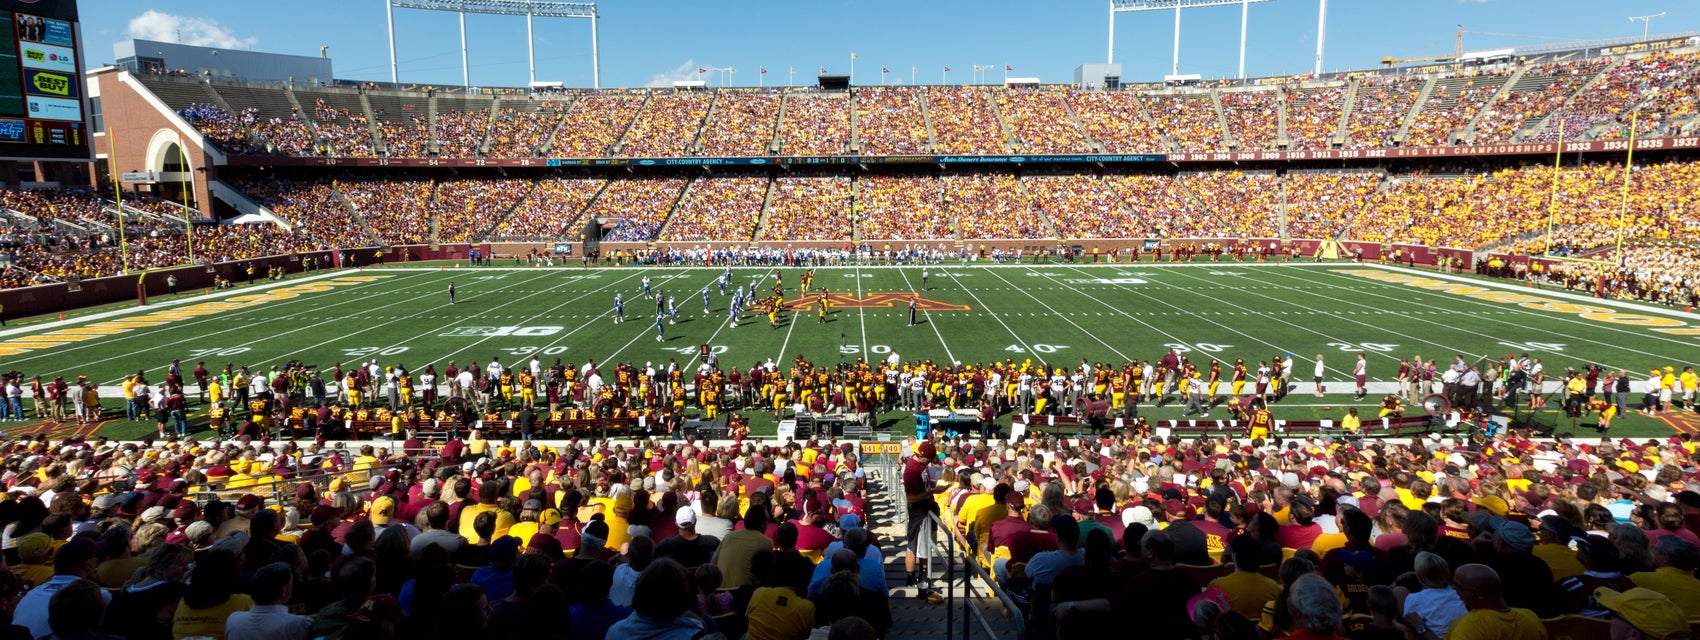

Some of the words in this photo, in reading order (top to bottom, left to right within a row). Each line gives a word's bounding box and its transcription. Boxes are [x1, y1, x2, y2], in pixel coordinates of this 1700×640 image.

[38, 76, 67, 86] BEST
[40, 83, 65, 91] BUY
[1566, 142, 1591, 151] 1933
[1603, 140, 1629, 150] 1934
[1636, 139, 1664, 149] 1935
[1672, 137, 1699, 147] 1937
[1338, 150, 1359, 158] 1915
[1453, 144, 1553, 155] CHAMPIONSHIPS
[1286, 151, 1305, 159] 1910
[1312, 151, 1331, 159] 1911
[344, 346, 410, 356] 20
[509, 346, 569, 355] 30
[675, 345, 728, 355] 40
[839, 344, 892, 354] 50
[1004, 343, 1057, 353] 40
[1163, 343, 1224, 353] 30
[1326, 342, 1395, 352] 20
